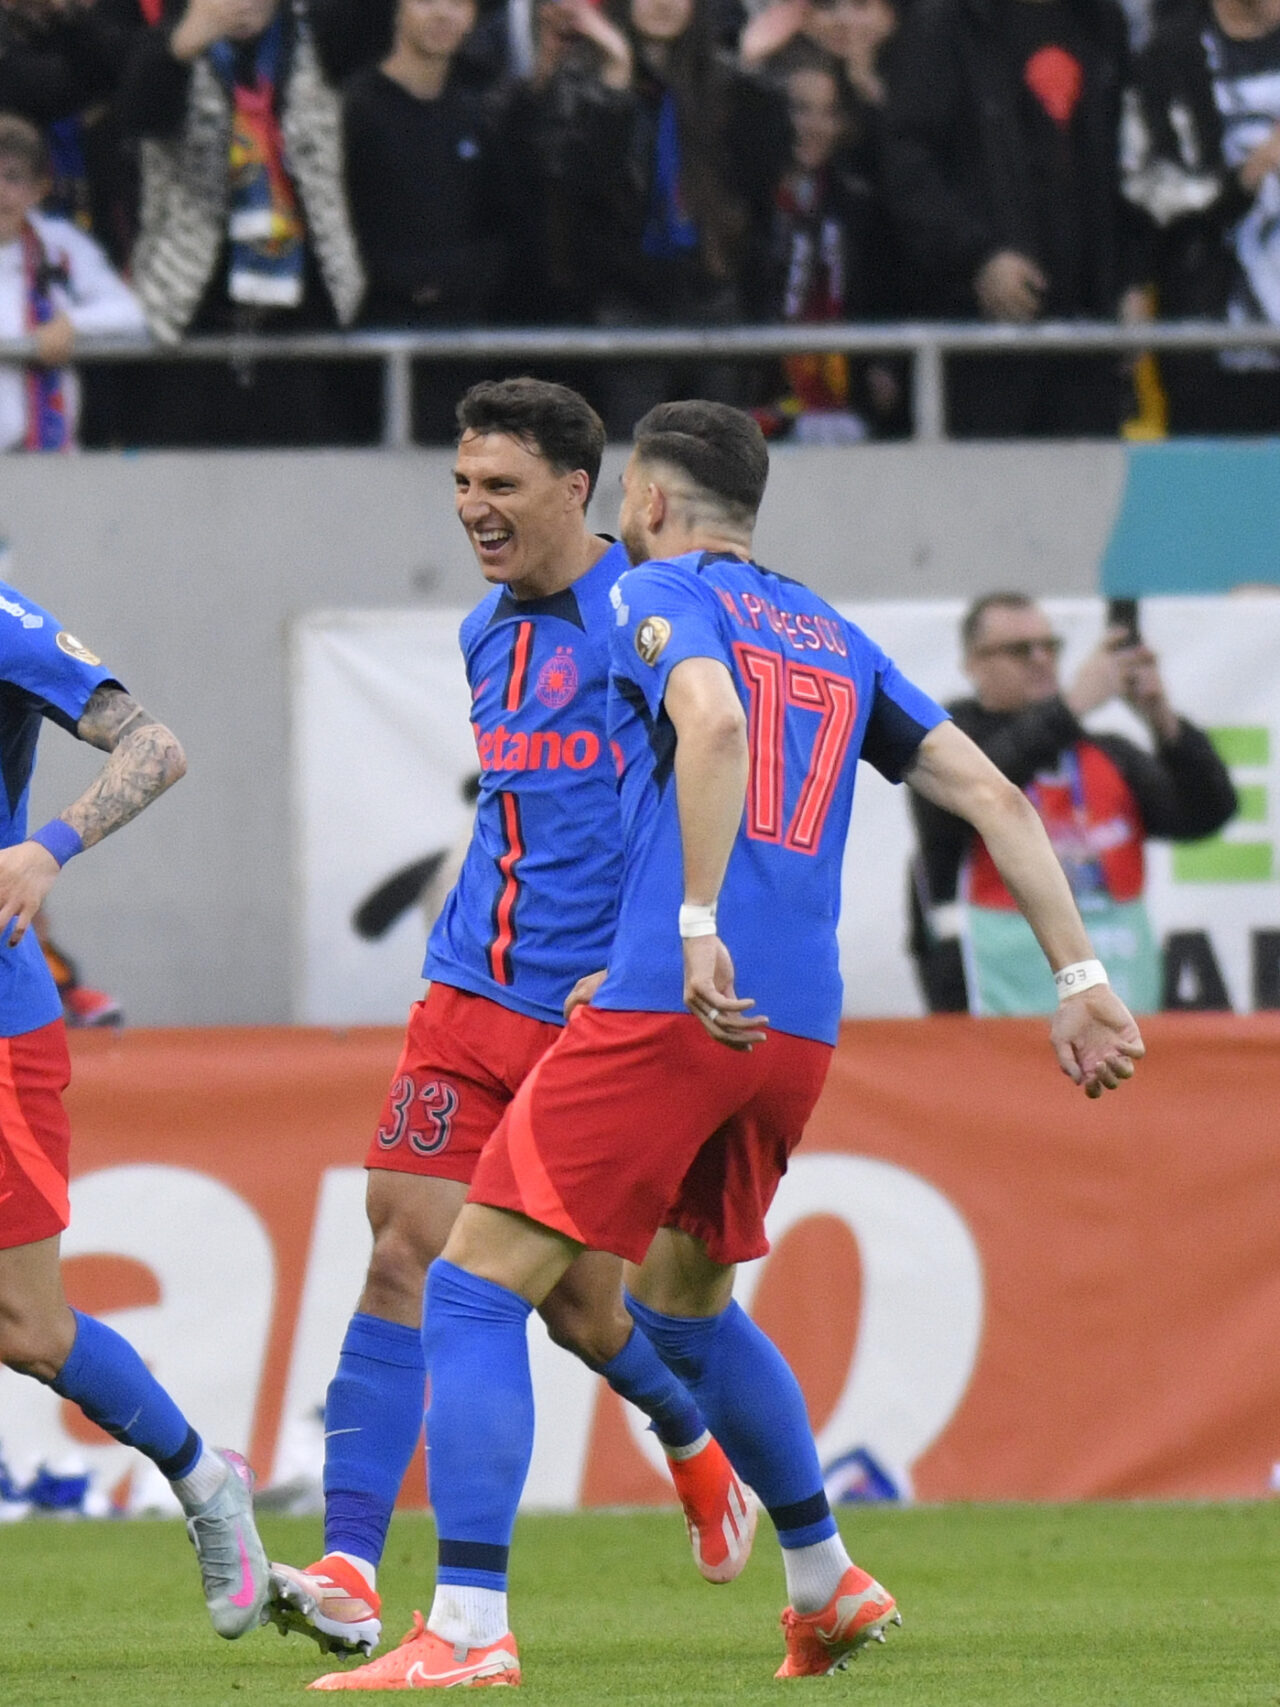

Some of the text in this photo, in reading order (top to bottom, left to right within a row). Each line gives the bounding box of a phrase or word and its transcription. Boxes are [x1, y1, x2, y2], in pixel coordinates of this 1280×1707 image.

[473, 722, 600, 771] etano
[731, 641, 858, 857] 17
[378, 1075, 459, 1157] 33
